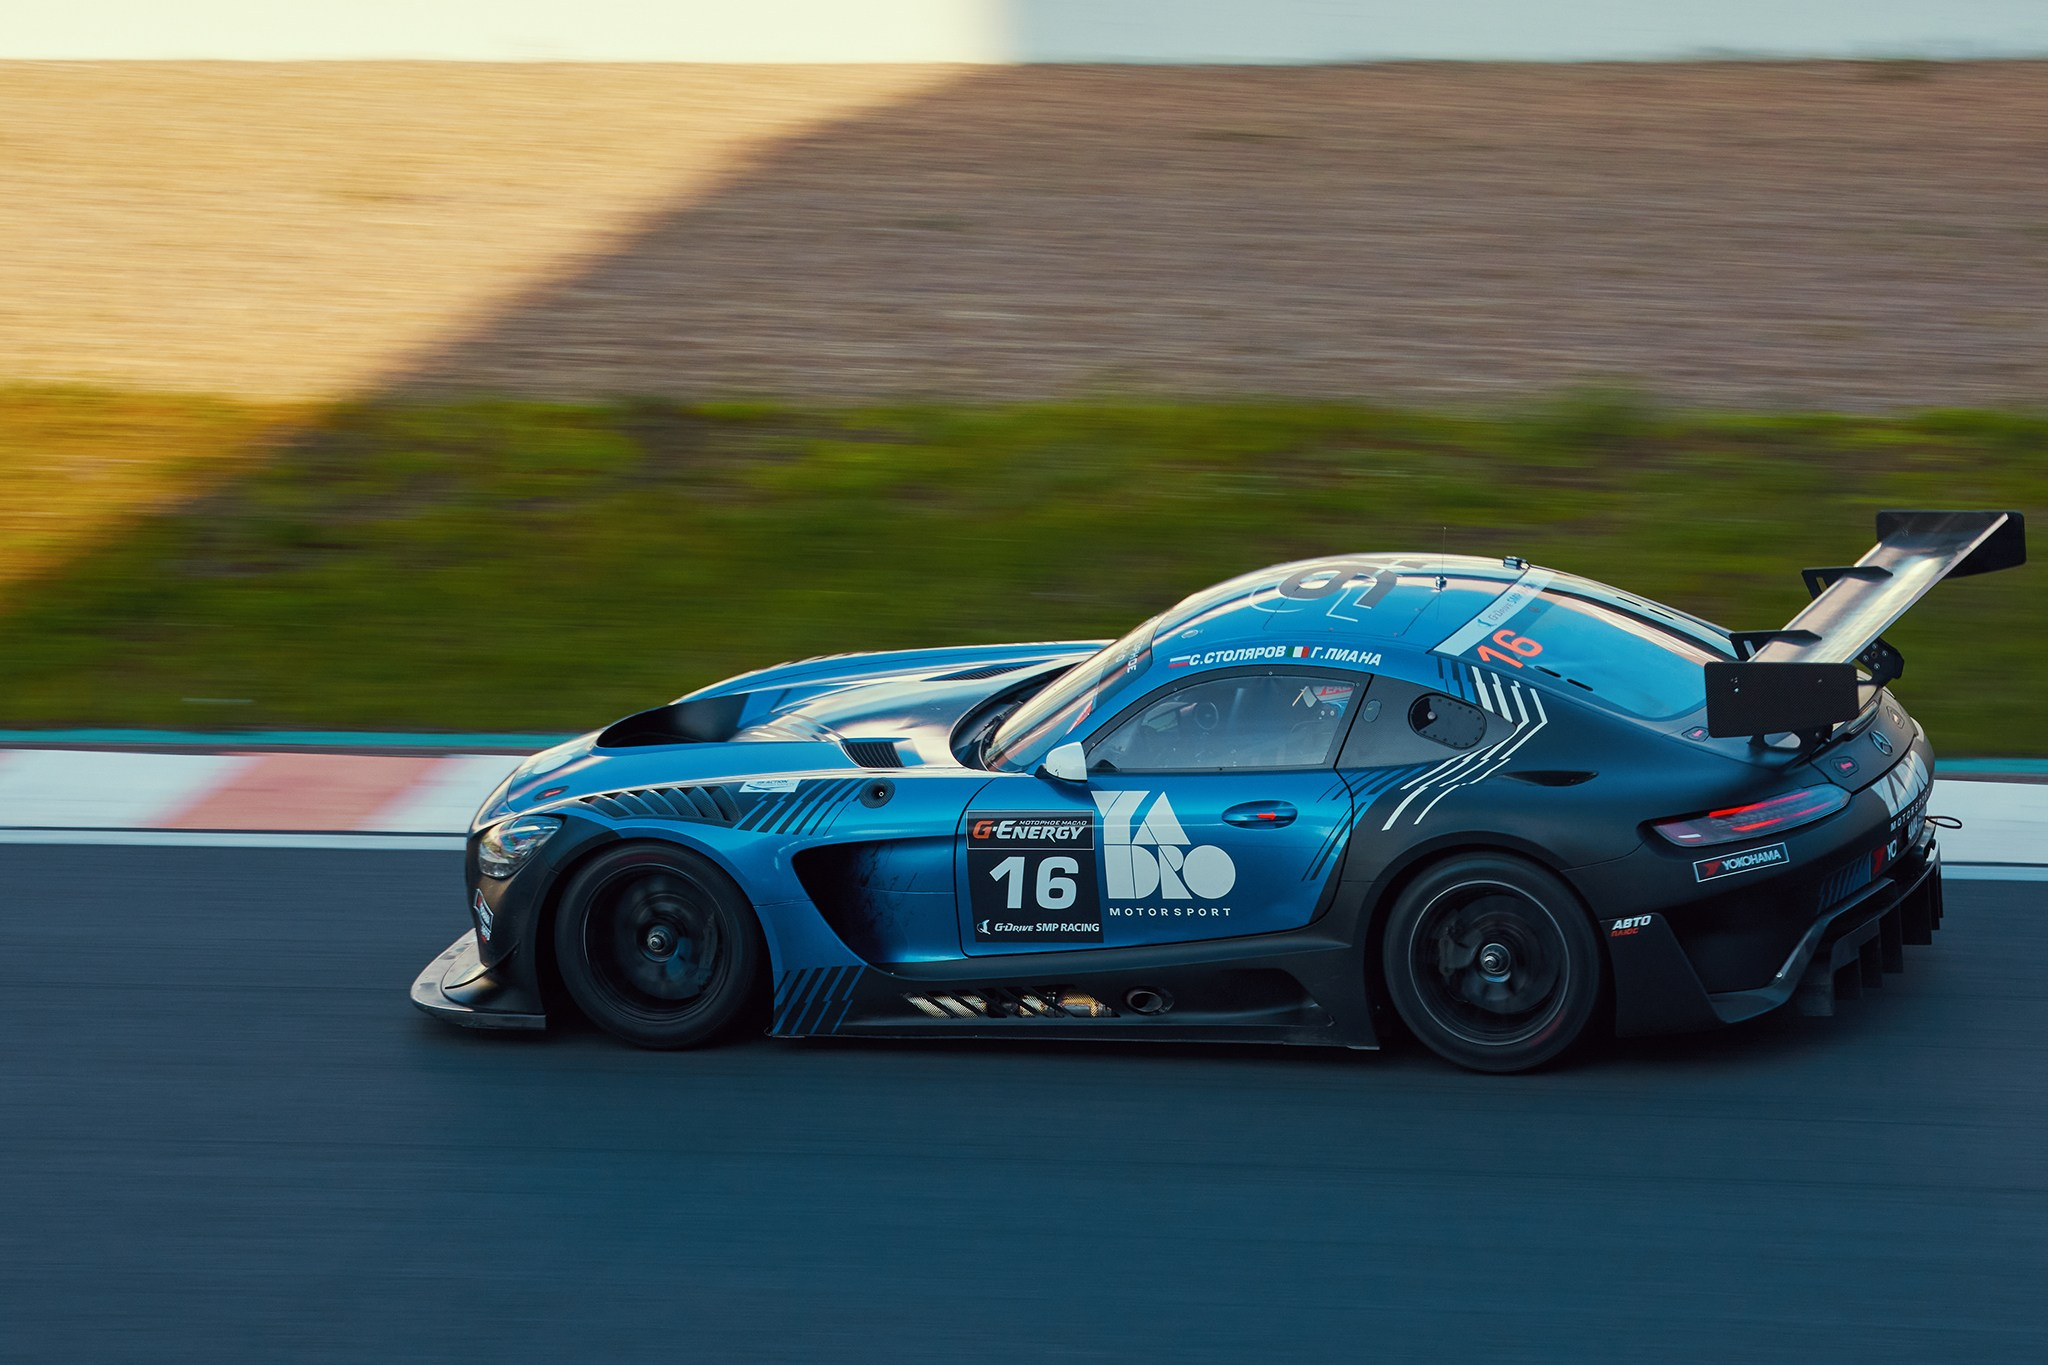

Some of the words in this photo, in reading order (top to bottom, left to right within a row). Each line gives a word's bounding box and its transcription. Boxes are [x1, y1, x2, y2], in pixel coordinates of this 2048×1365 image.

[1189, 646, 1286, 666] С.СТОЛЯРОВ
[1310, 647, 1382, 666] Г.ПИАНА
[1477, 629, 1543, 669] 16
[1721, 849, 1782, 871] YOKOHAMA
[989, 856, 1079, 910] 16
[1109, 907, 1232, 916] MOTORSPORT
[1035, 922, 1060, 932] SMP
[1060, 922, 1100, 932] RACING
[1611, 915, 1652, 930] АВТО
